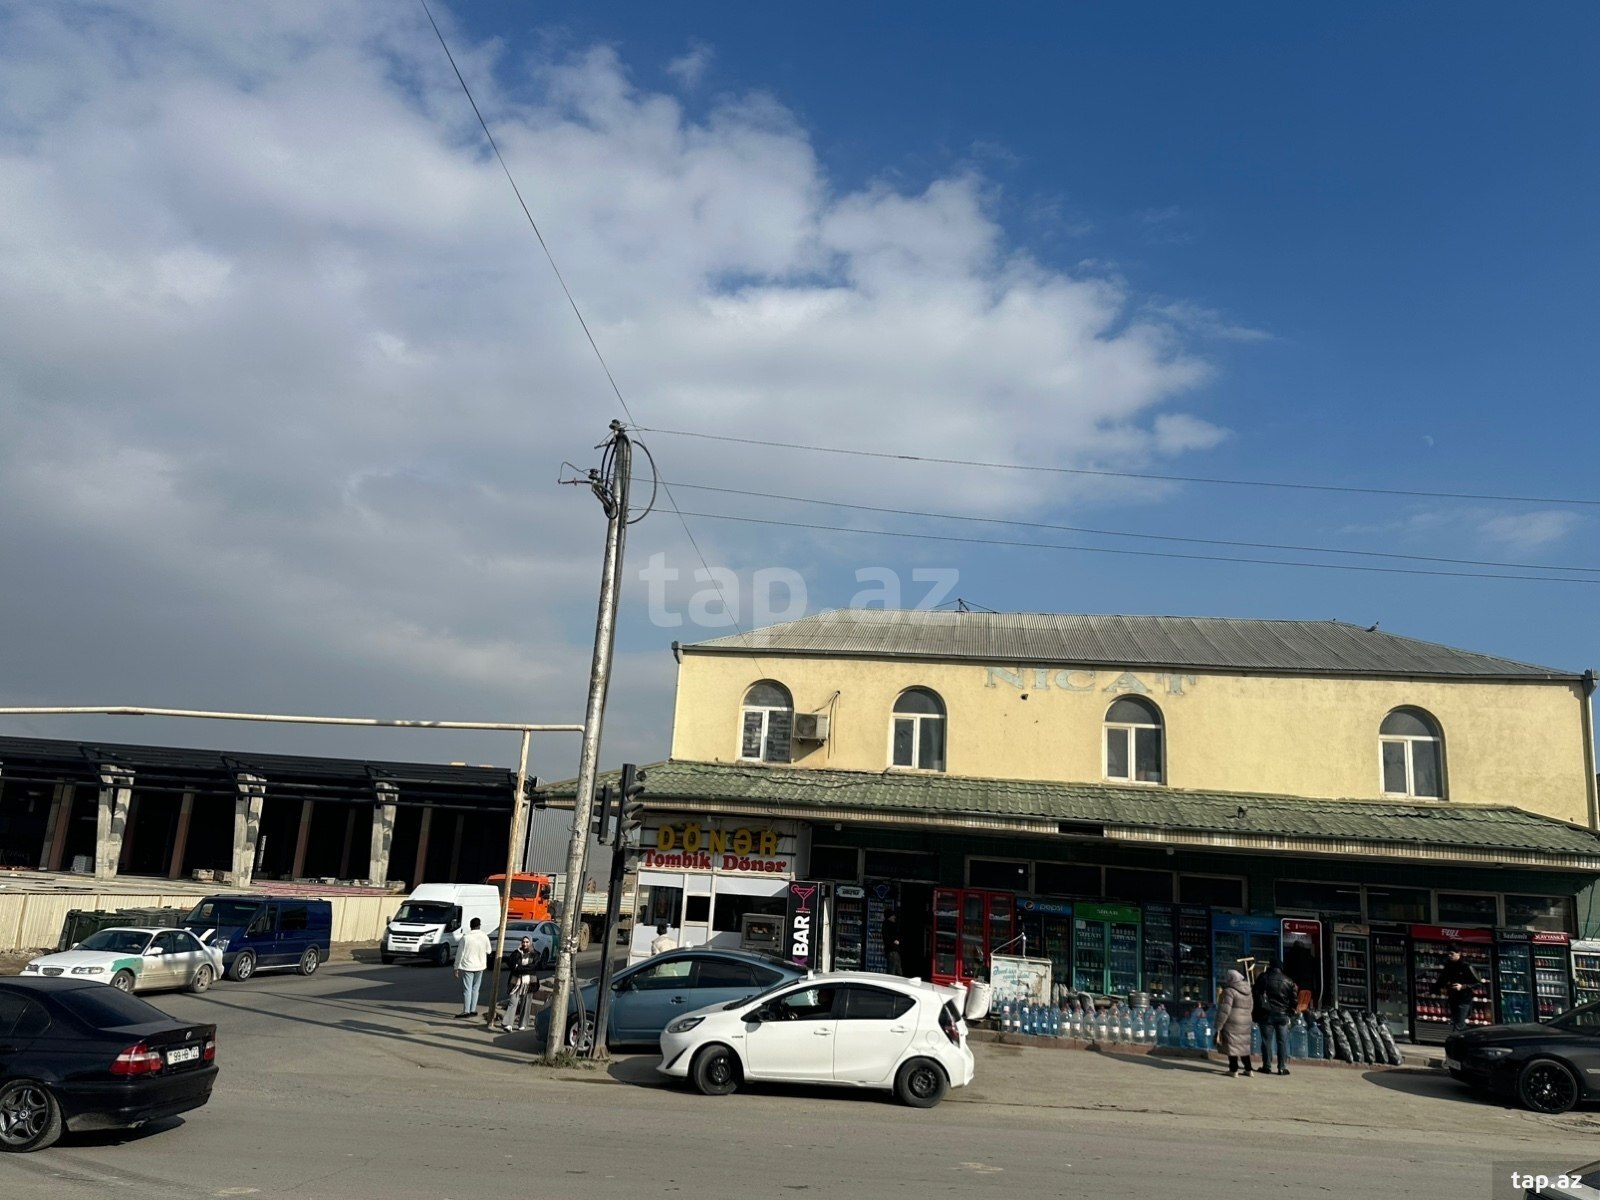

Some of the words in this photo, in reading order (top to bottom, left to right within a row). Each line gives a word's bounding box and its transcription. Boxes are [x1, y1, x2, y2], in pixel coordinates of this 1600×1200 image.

[657, 823, 777, 857] DÖNƏR
[645, 849, 712, 869] Tombik
[722, 855, 787, 873] Dönər
[1039, 903, 1063, 911] pepsi
